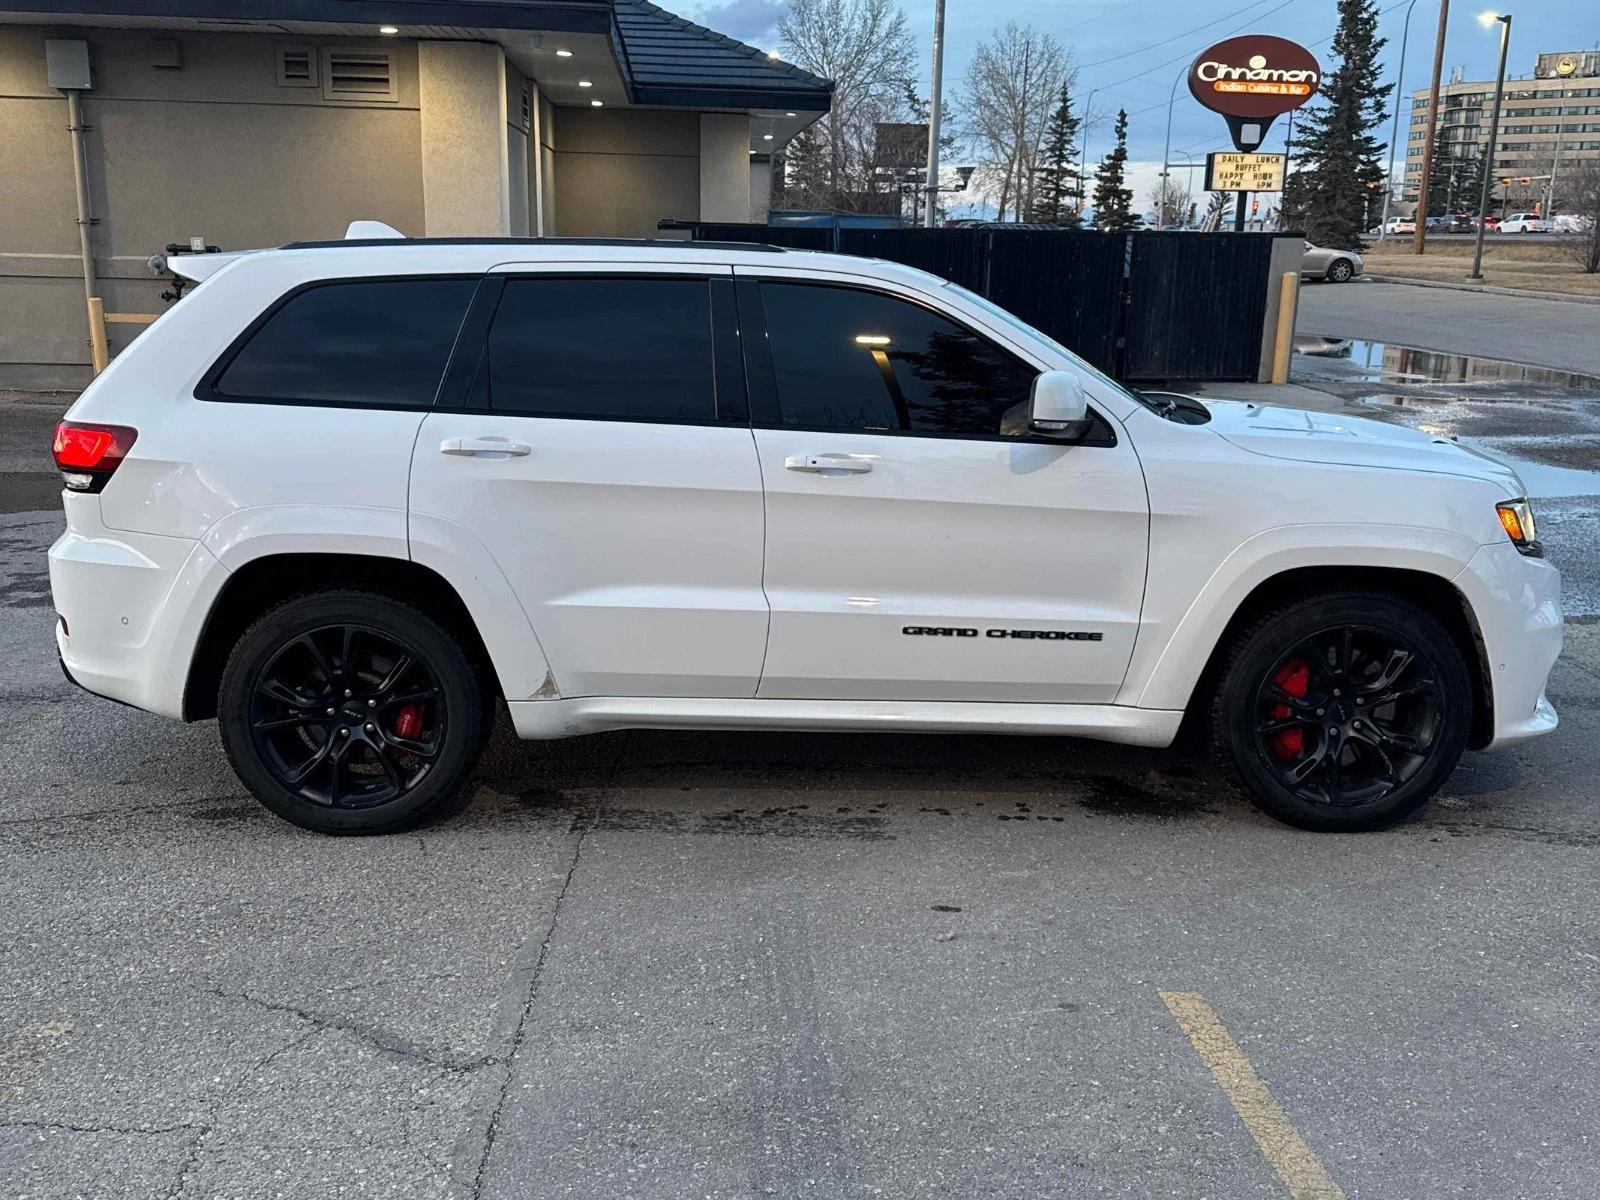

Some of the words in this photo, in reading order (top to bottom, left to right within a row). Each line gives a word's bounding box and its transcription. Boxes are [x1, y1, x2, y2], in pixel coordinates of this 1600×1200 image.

[1197, 61, 1318, 83] Cinnamon
[1219, 83, 1247, 91] Indian
[1248, 84, 1279, 93] Cuisine
[1280, 85, 1288, 93] &
[1289, 85, 1305, 94] Bar
[1222, 155, 1246, 163] DAILY
[1255, 155, 1280, 163] LUNCH
[1218, 172, 1244, 180] HAPPY
[1256, 181, 1272, 189] 6PM
[902, 626, 978, 638] GRAND
[985, 629, 1103, 641] CHEROKEE
